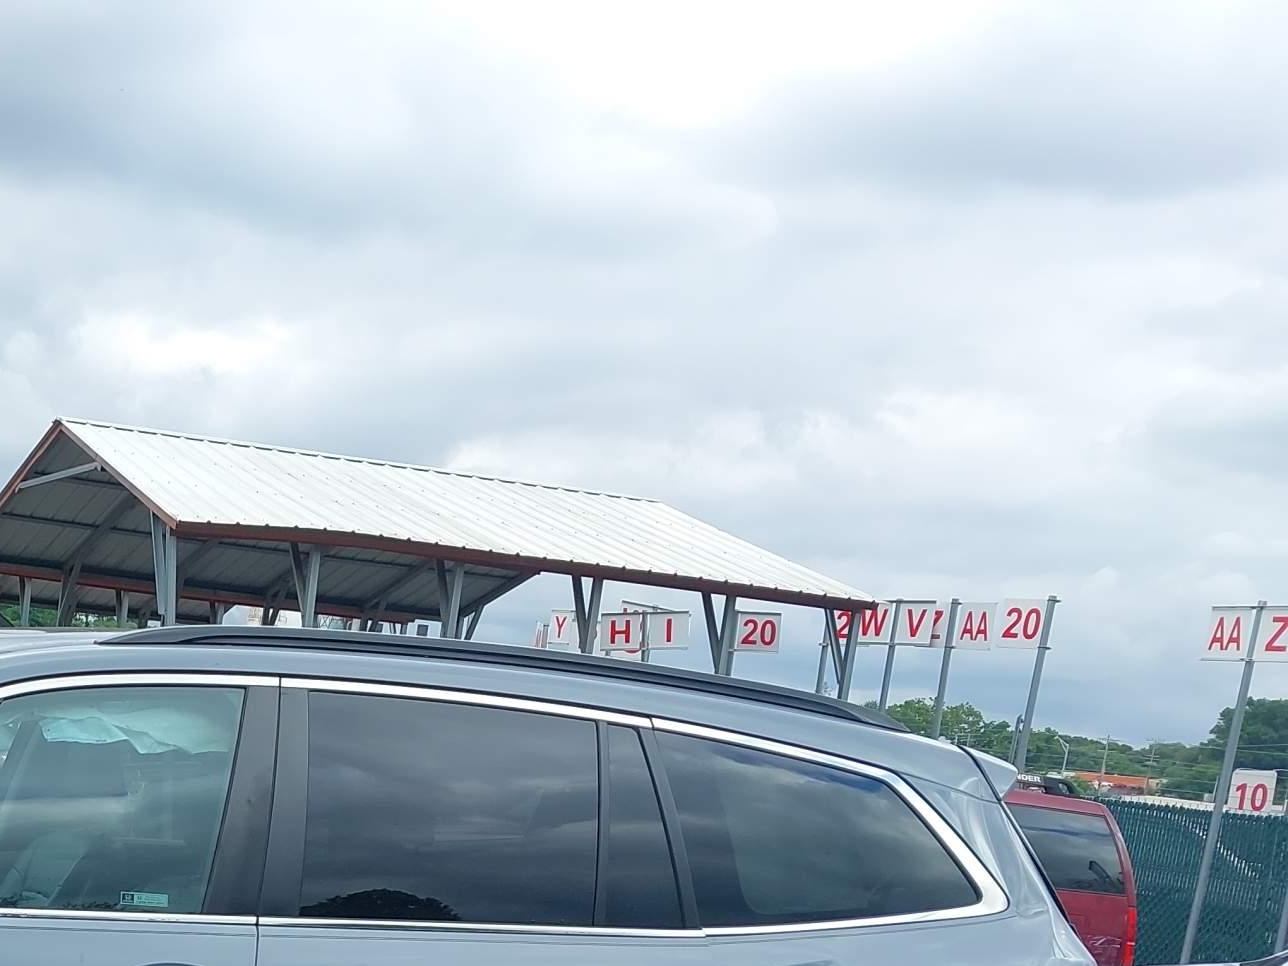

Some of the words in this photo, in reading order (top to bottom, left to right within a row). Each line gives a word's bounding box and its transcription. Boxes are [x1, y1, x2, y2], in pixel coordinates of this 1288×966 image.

[556, 616, 567, 638] Y
[610, 620, 630, 644] H
[741, 619, 776, 646] 20
[861, 609, 888, 637] W
[907, 609, 927, 637] V
[960, 611, 987, 641] AA
[1001, 607, 1041, 640] 20
[1208, 616, 1241, 651] AA
[1265, 616, 1288, 651] Z
[1235, 783, 1268, 811] 10
